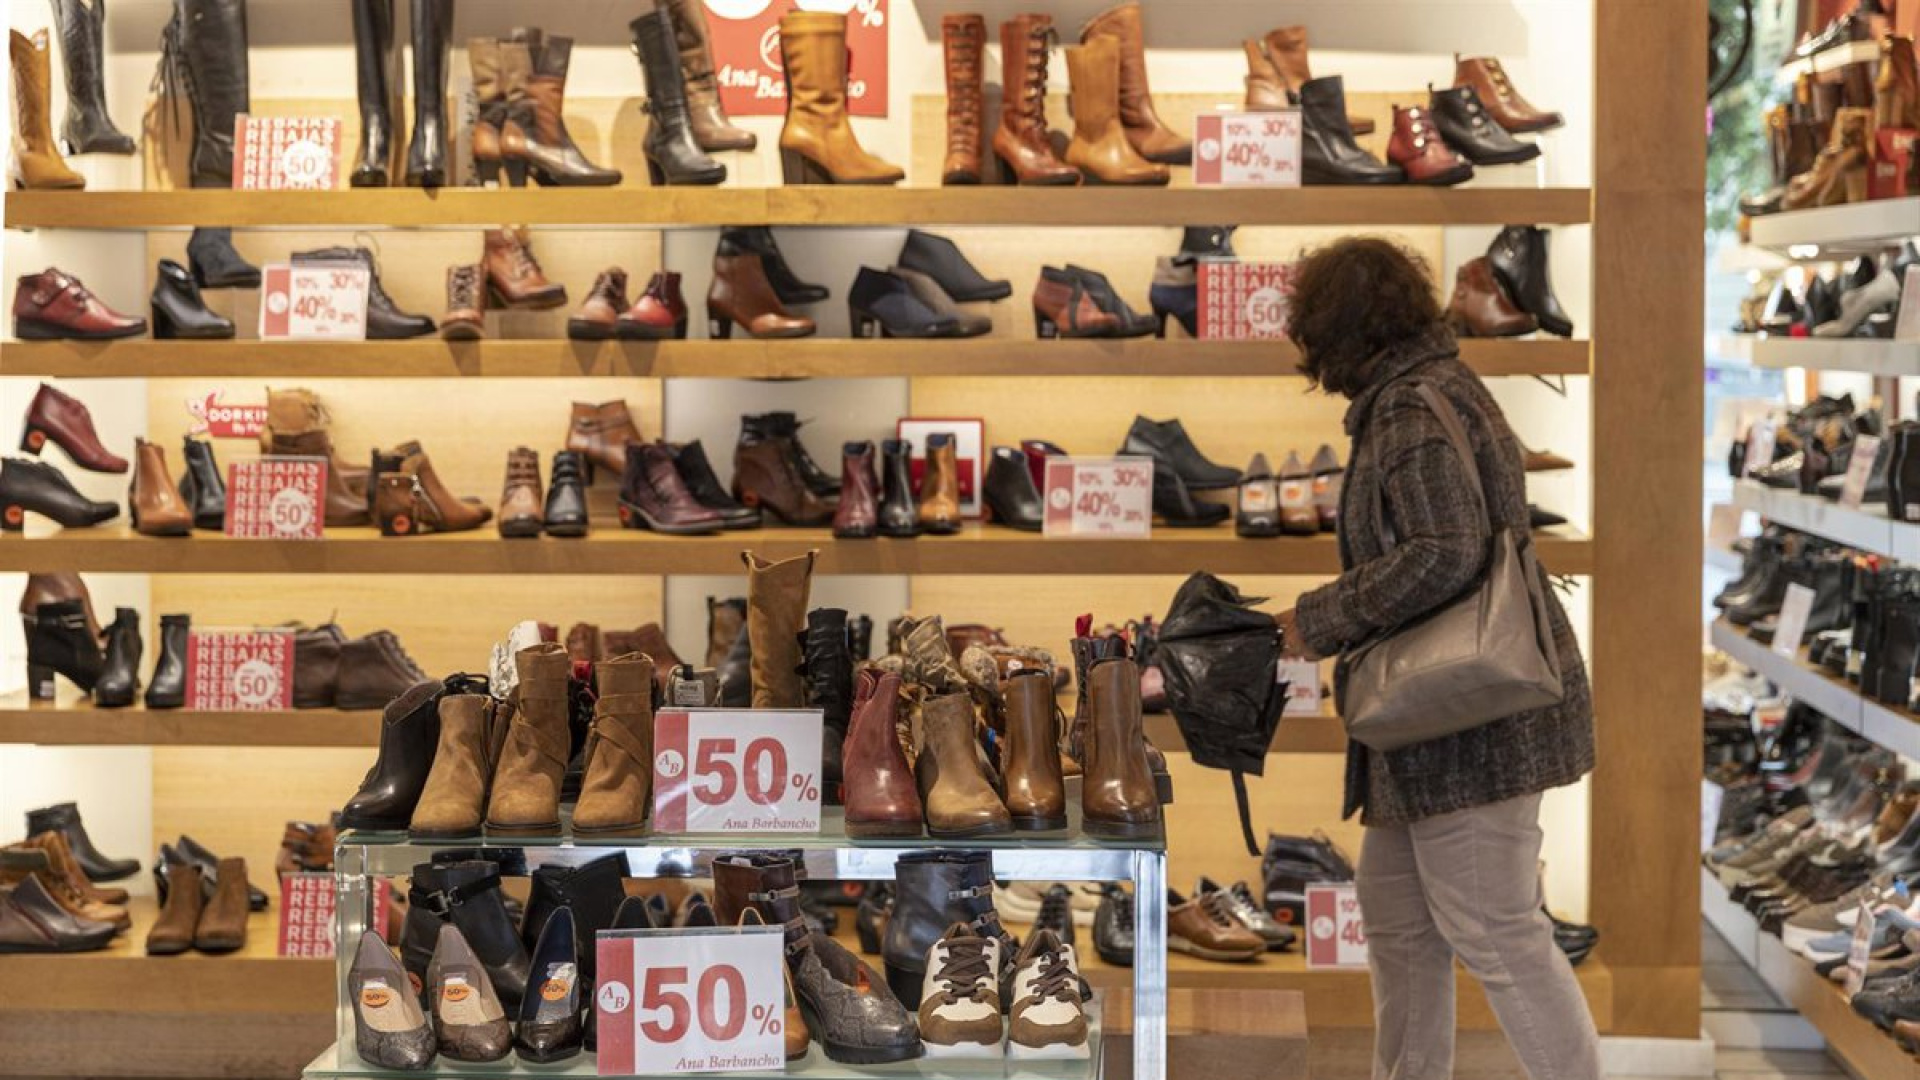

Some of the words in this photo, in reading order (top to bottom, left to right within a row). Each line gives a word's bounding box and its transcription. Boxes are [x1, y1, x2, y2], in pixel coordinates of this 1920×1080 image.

[718, 64, 758, 86] Ana
[245, 129, 334, 143] REBAJAS
[1226, 141, 1271, 167] 40%
[294, 295, 337, 319] 40%
[235, 475, 318, 489] REBAJAS
[1077, 491, 1122, 518] 40%
[196, 647, 284, 662] REBAJAS
[692, 736, 818, 806] 50%
[723, 818, 749, 830] Ana
[752, 817, 817, 830] Barbancho
[640, 964, 782, 1044] 50%
[675, 1056, 704, 1070] Ana
[709, 1053, 780, 1068] Barbancho
